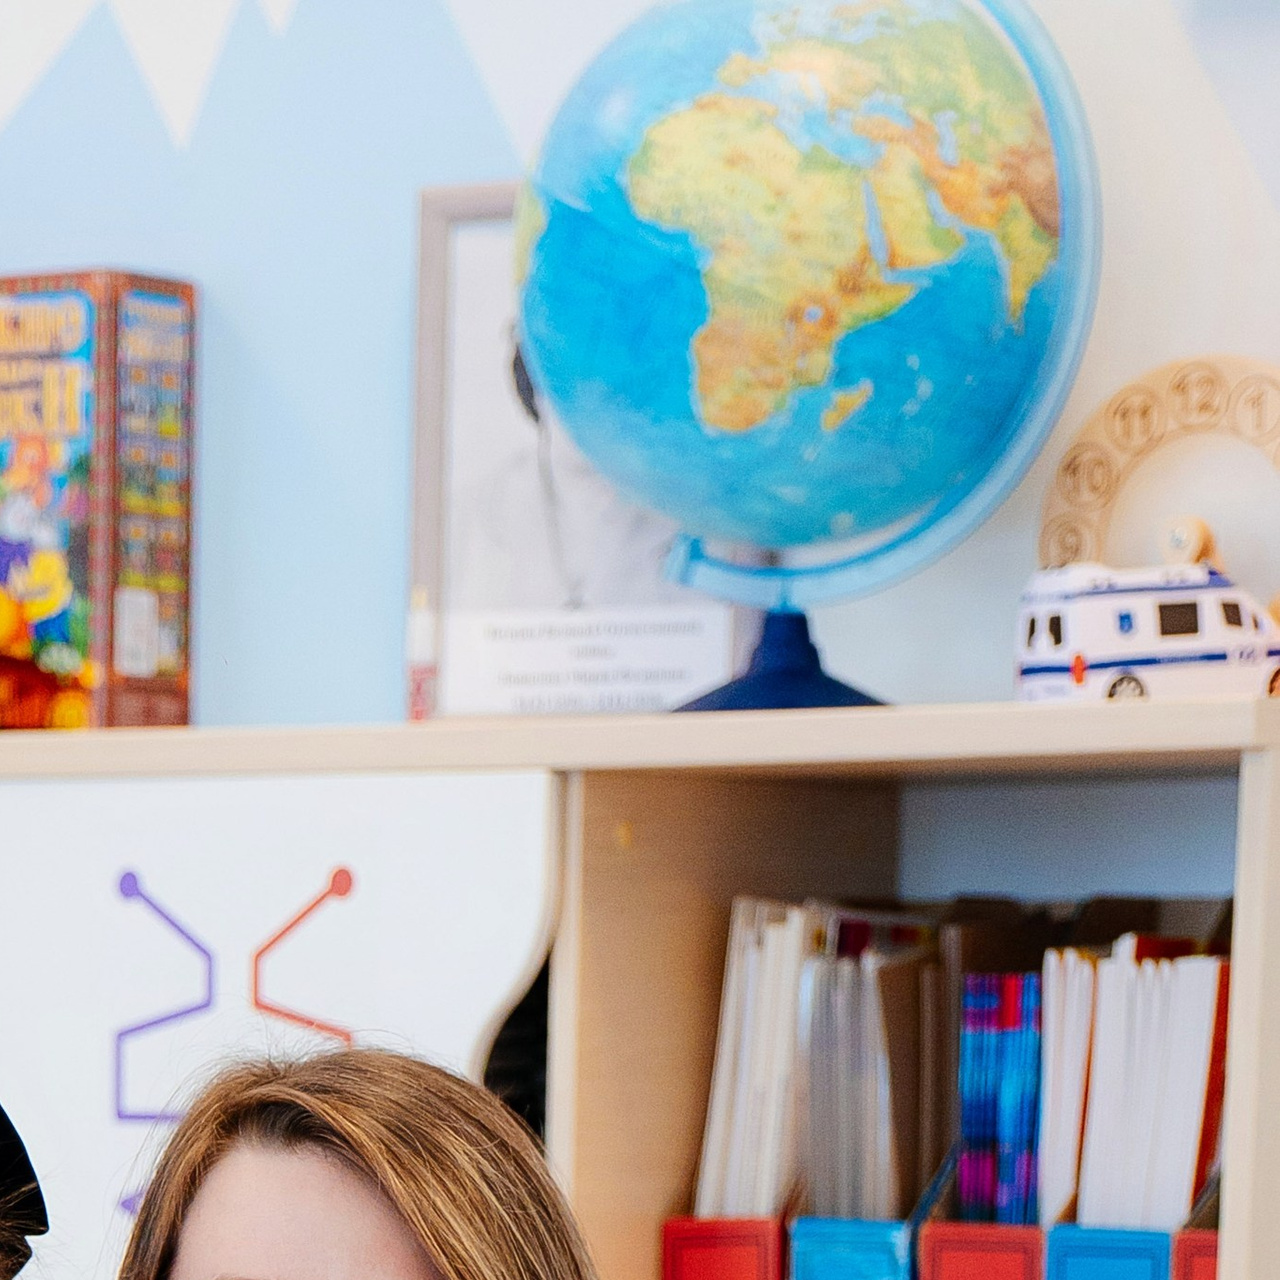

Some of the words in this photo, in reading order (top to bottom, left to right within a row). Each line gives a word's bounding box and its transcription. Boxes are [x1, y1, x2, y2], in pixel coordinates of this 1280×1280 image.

[1171, 374, 1221, 418] 12
[1113, 403, 1154, 444] 11
[1060, 456, 1108, 497] 10
